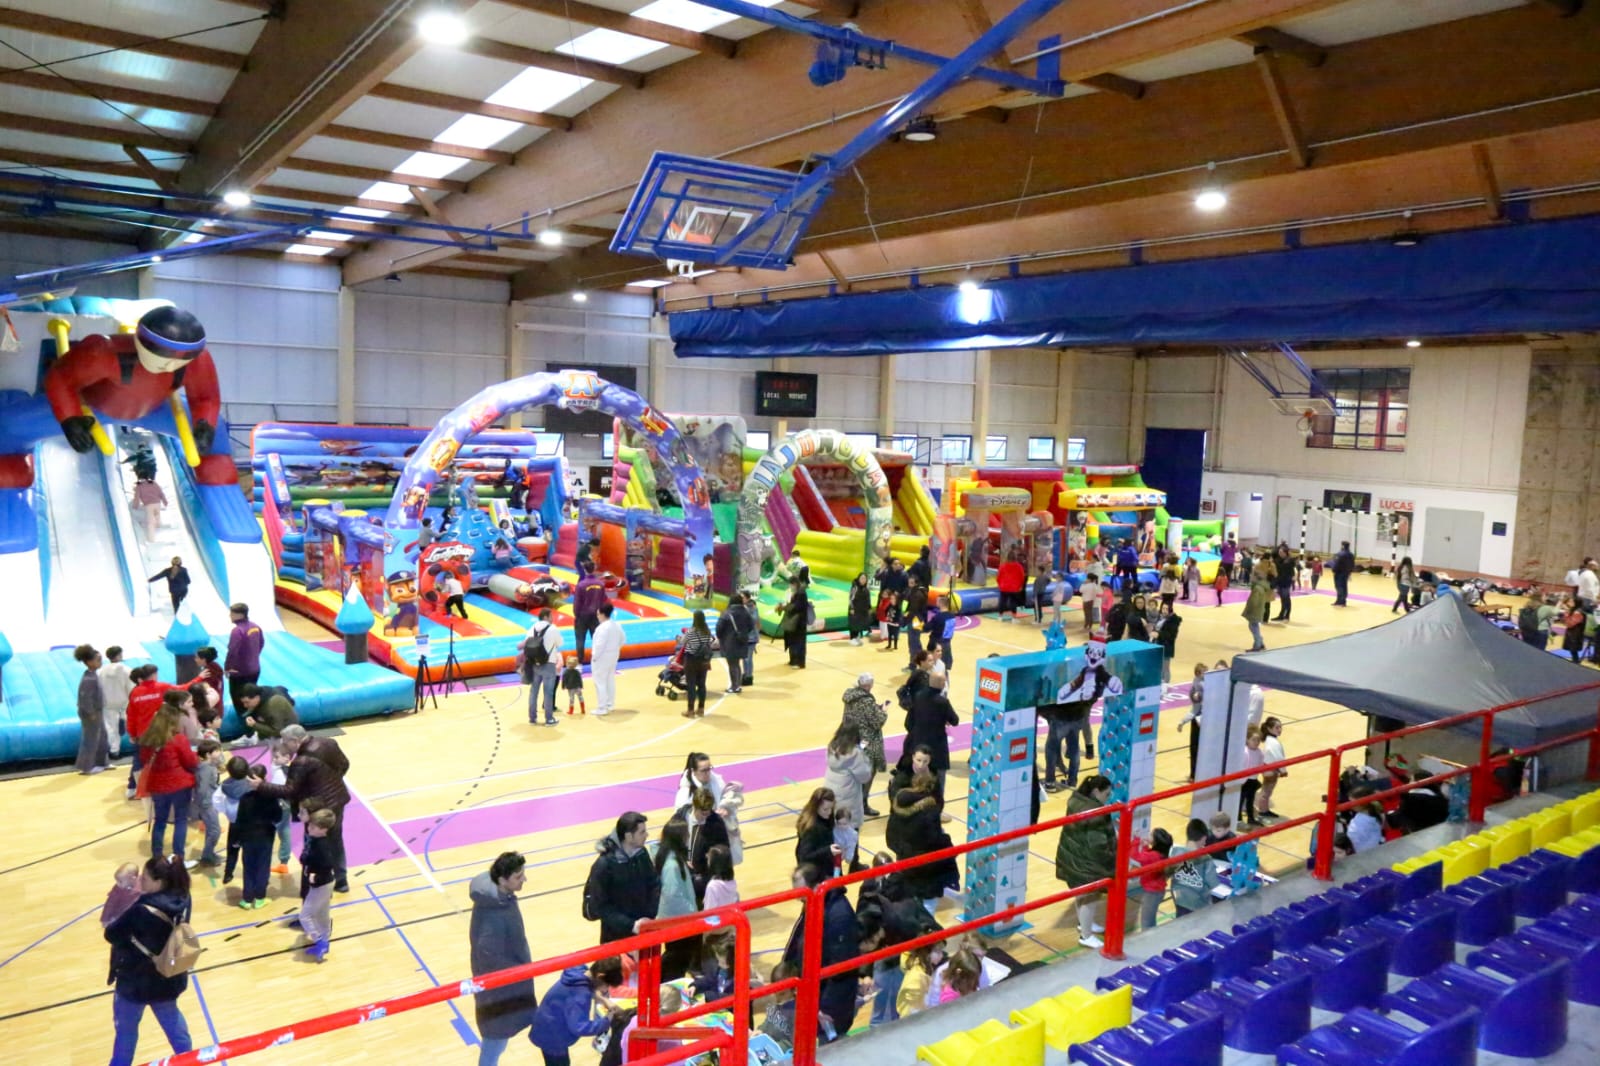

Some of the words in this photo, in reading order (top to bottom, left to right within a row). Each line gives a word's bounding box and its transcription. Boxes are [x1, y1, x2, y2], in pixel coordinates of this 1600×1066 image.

[753, 459, 783, 489] LA
[779, 433, 882, 487] JUNGLA
[1379, 499, 1415, 511] LUCAS
[981, 679, 1000, 692] LEGO
[1010, 743, 1027, 755] LEGO
